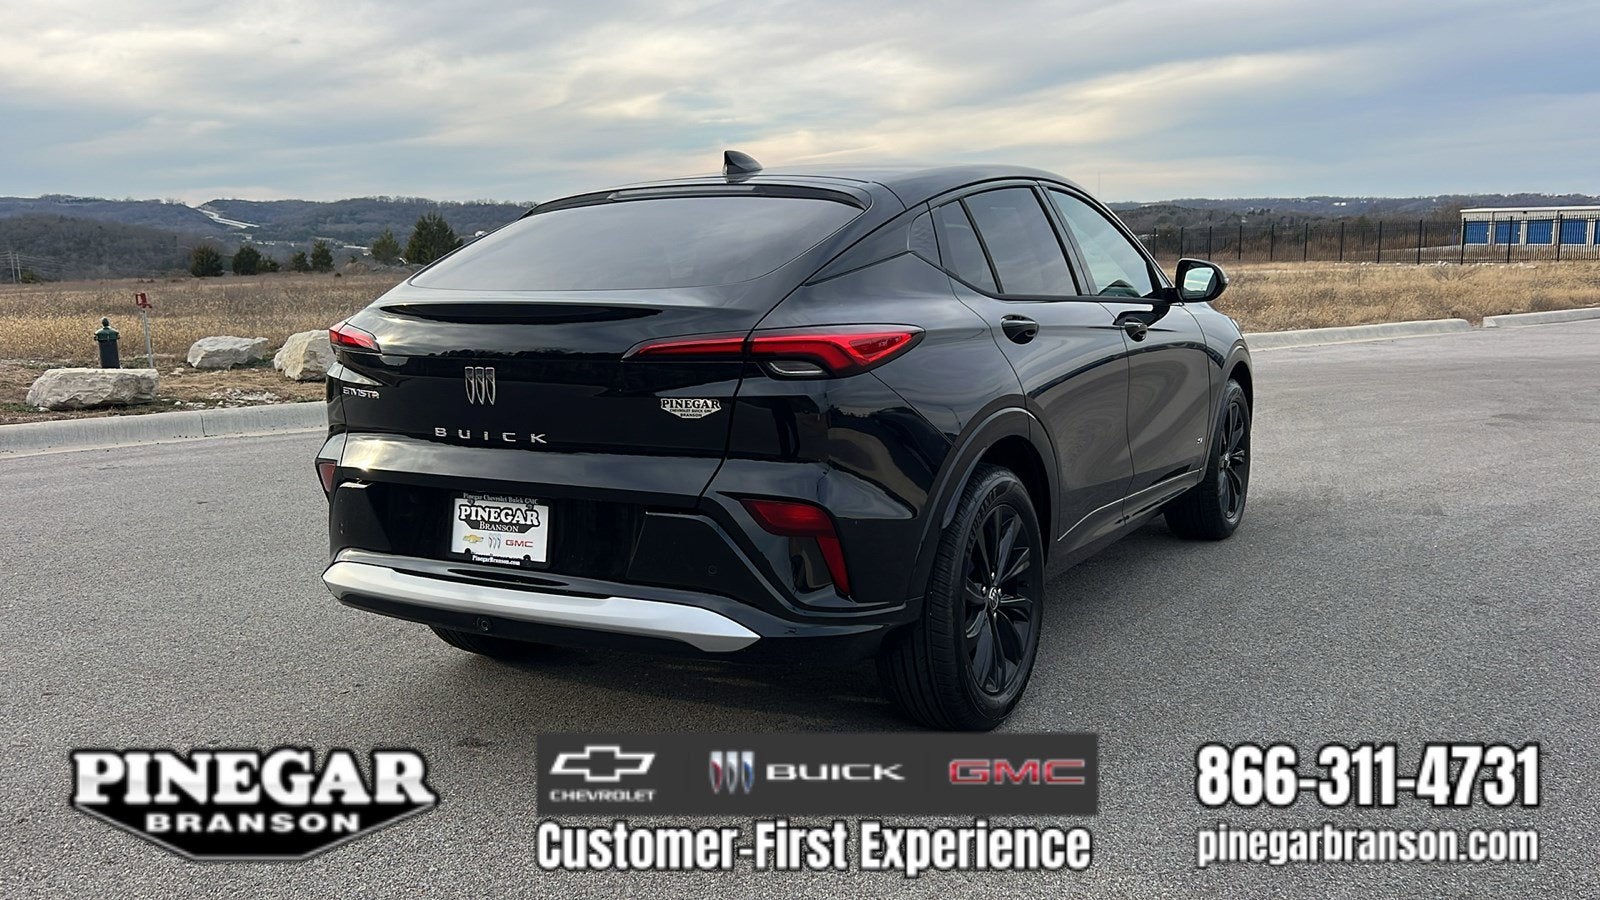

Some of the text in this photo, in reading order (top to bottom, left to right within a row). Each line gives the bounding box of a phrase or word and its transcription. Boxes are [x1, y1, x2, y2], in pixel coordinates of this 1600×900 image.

[662, 399, 719, 408] PINEGAR
[434, 427, 547, 444] BUICK
[463, 492, 482, 500] Pinegar
[483, 494, 508, 502] Chevrolet
[460, 506, 540, 526] PINEGAR
[505, 539, 533, 547] GMC
